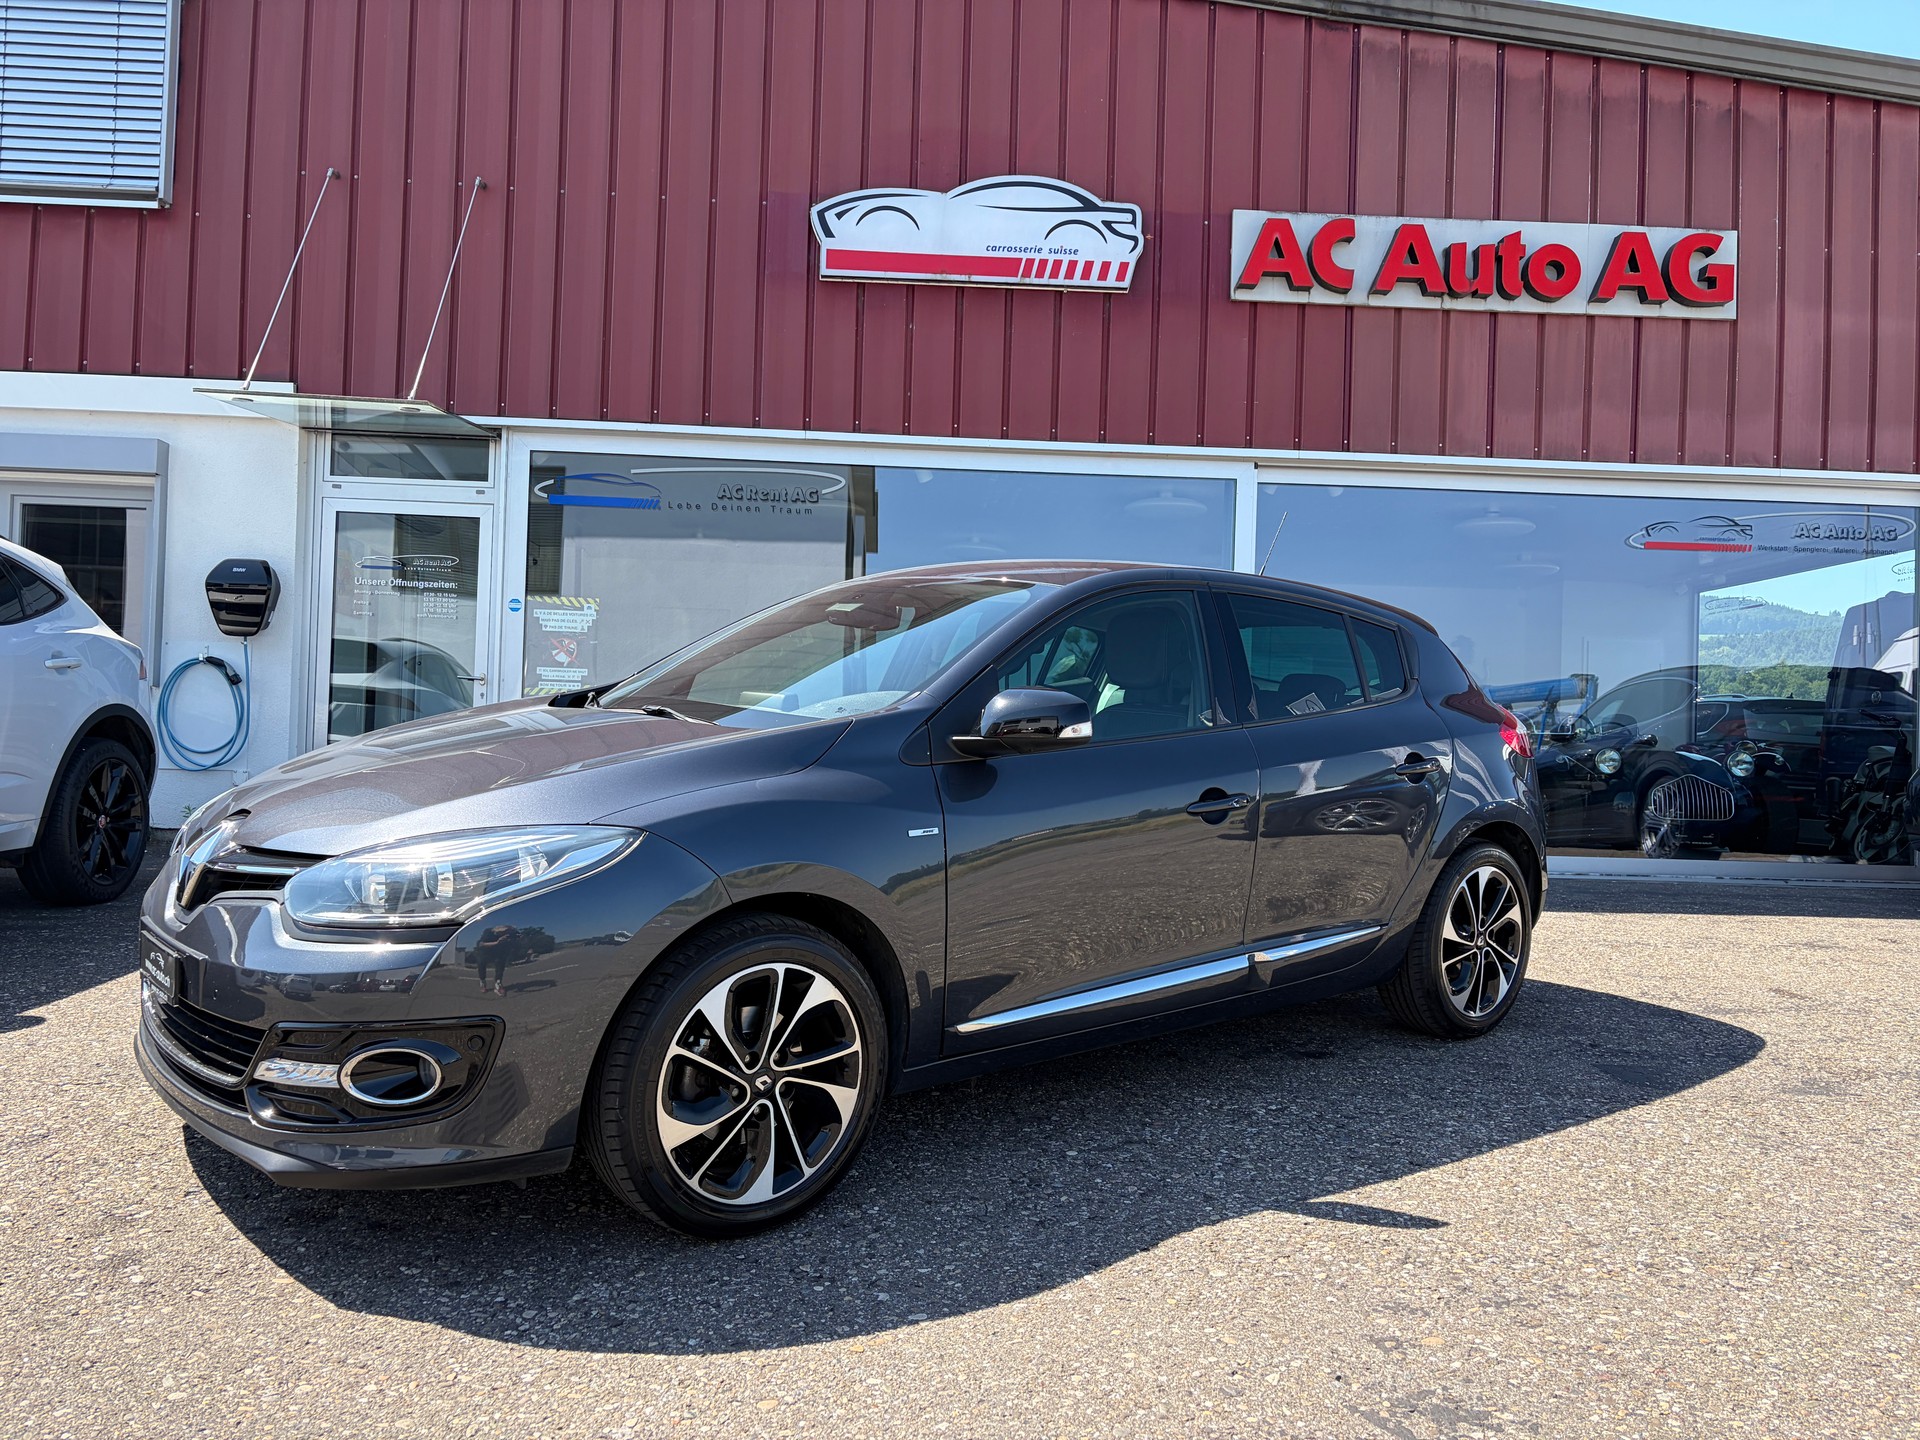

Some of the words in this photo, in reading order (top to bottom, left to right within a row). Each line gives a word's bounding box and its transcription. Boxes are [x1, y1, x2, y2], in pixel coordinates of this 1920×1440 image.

[986, 244, 1043, 254] carrosserie
[1047, 245, 1079, 256] suisse
[1236, 218, 1356, 294] AC
[1369, 223, 1581, 302] Auto
[1589, 231, 1735, 307] AG
[717, 483, 743, 500] AC
[745, 484, 788, 502] Rent
[790, 487, 819, 503] AG
[668, 501, 701, 510] Lebe
[711, 502, 760, 513] Deinen
[770, 505, 812, 515] Traum
[1795, 523, 1821, 539] AC
[1824, 523, 1867, 540] Auto
[1869, 524, 1898, 541] AG
[354, 577, 386, 585] Unsere
[388, 577, 458, 589] Öffnungszeiten:
